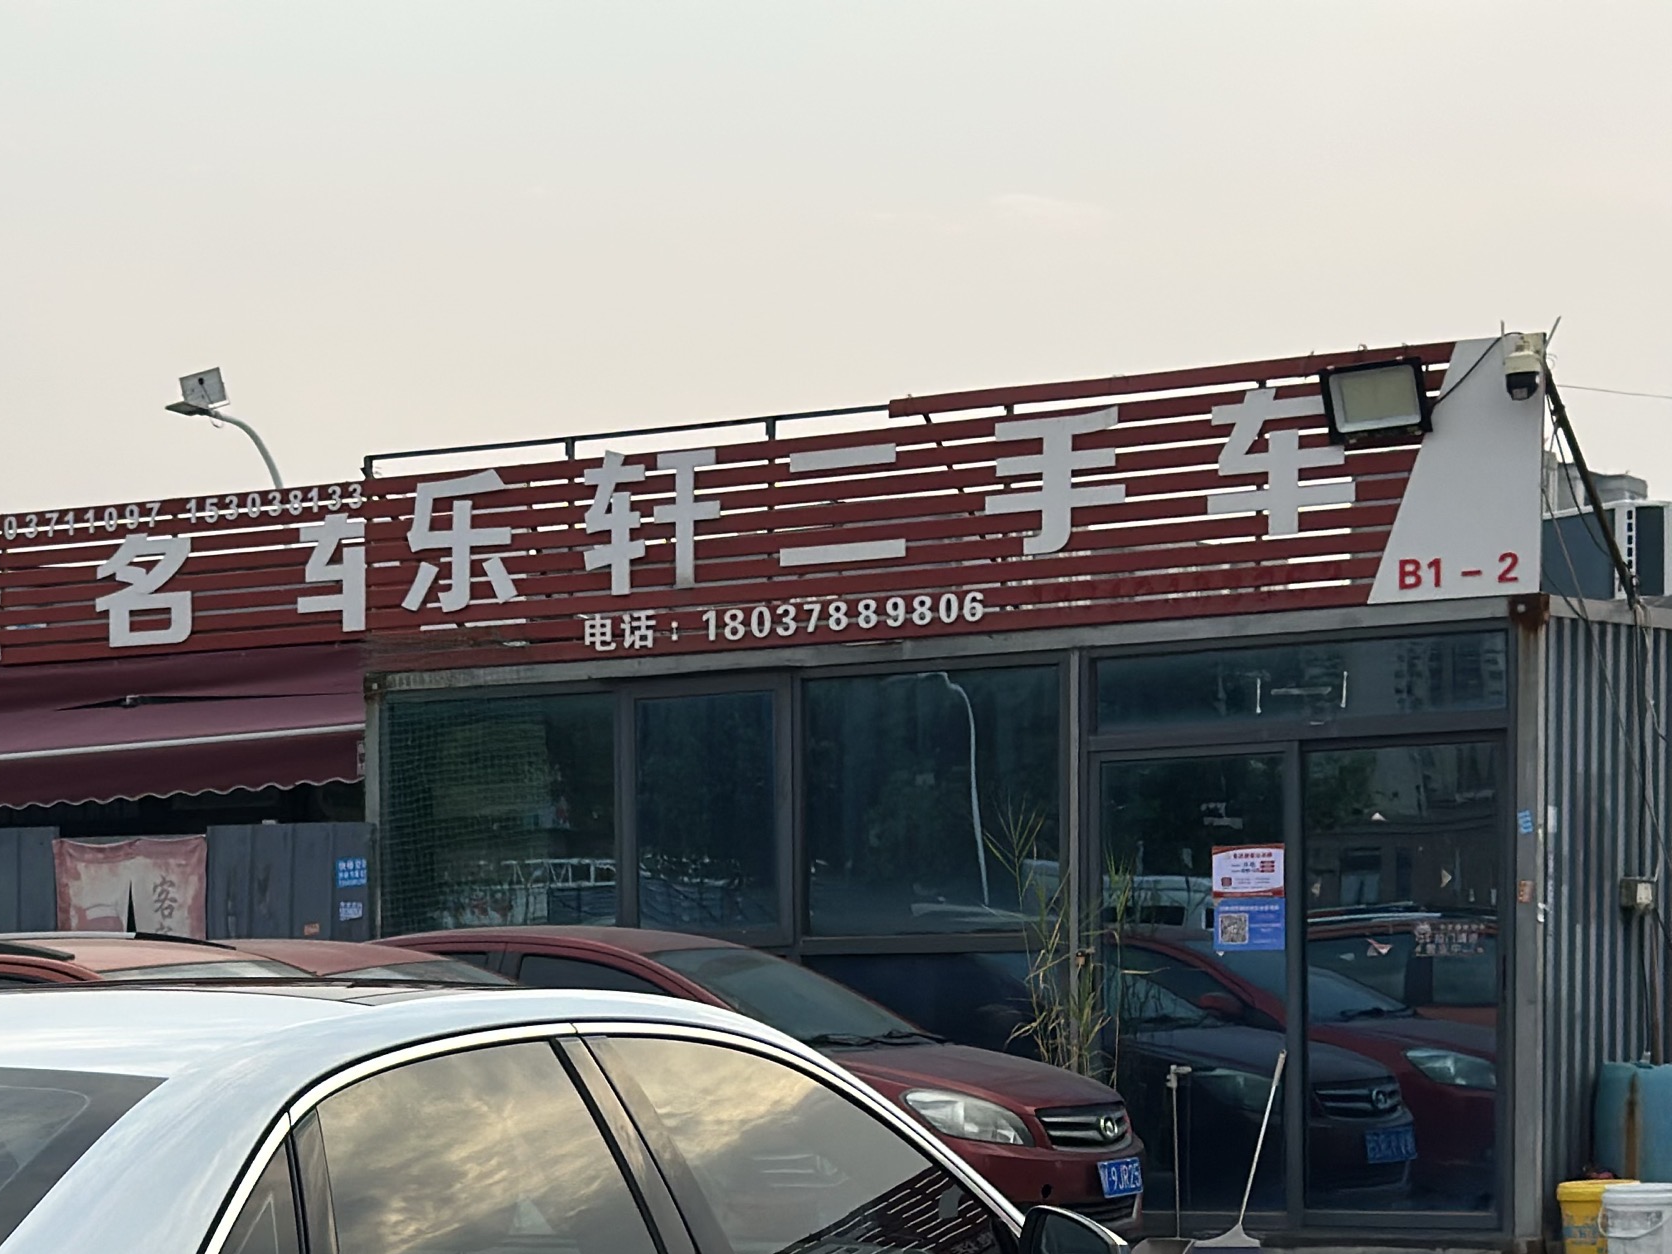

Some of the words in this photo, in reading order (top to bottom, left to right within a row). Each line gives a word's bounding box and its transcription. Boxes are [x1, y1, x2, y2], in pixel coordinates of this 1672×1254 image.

[401, 388, 1356, 613] 乐轩二手车
